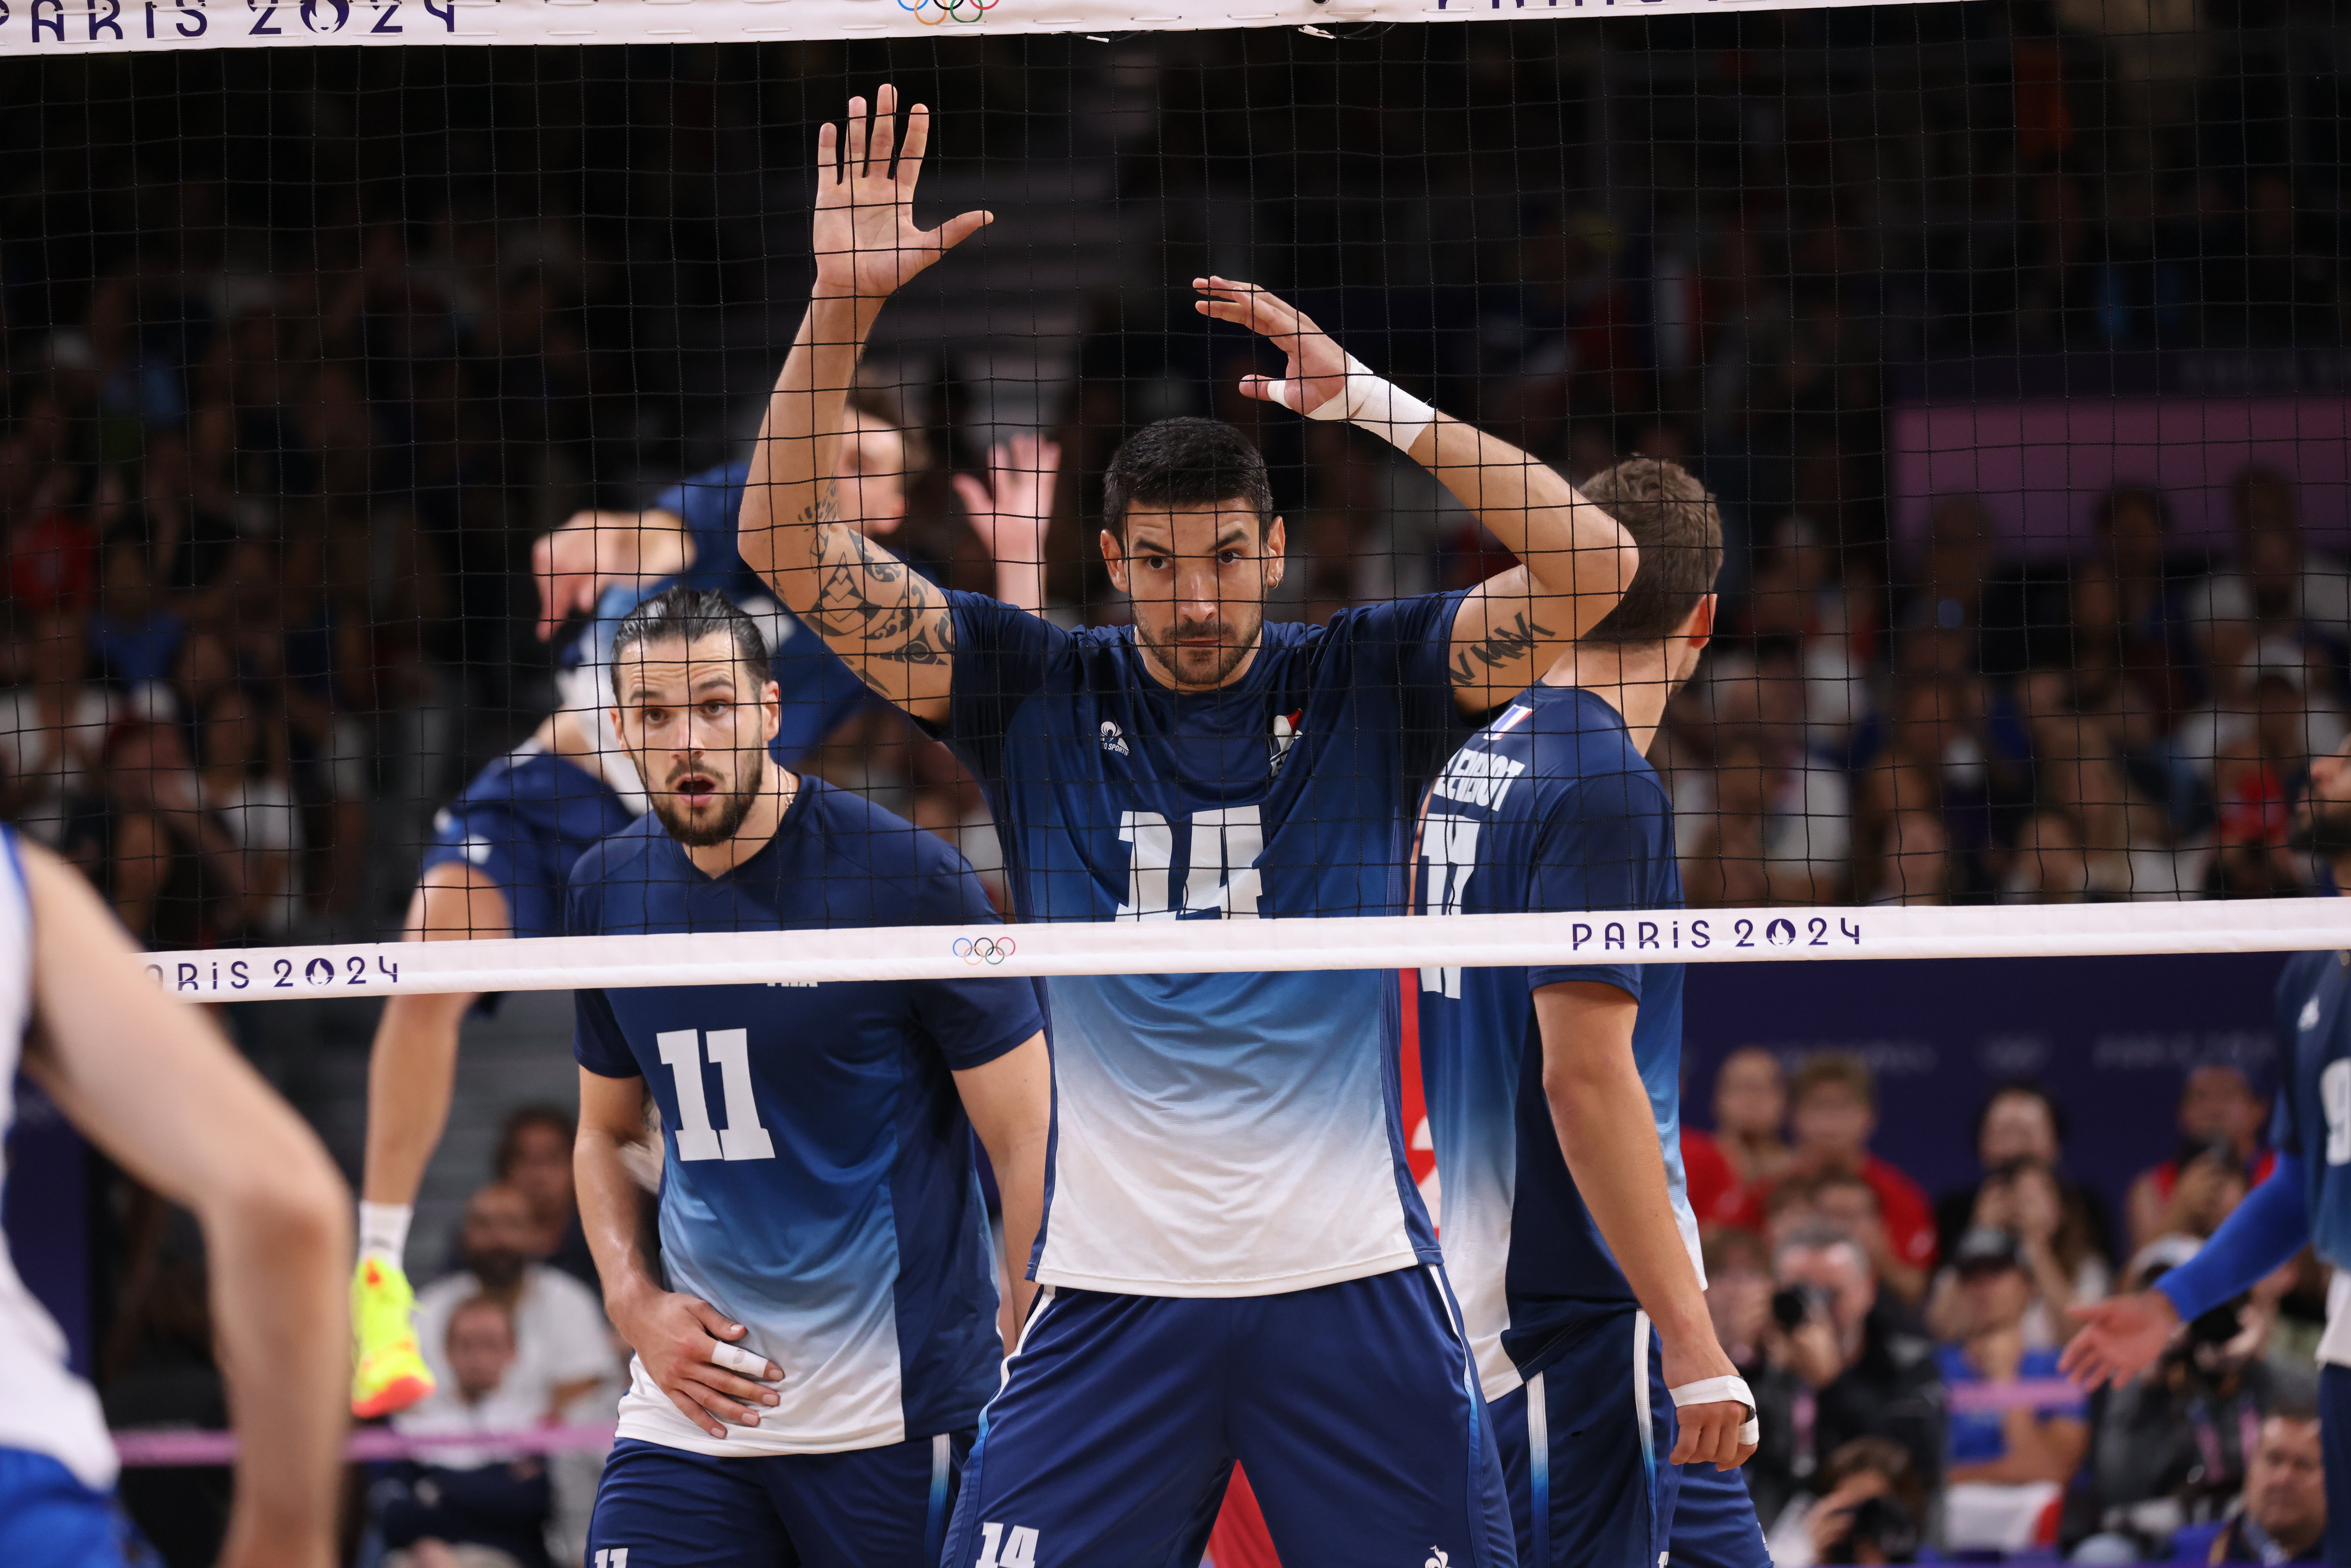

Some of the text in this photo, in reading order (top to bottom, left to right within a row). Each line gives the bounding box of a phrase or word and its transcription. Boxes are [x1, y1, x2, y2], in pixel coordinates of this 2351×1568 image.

[0, 0, 207, 43] ARiS
[1108, 743, 1129, 756] SPORTIF
[1115, 805, 1264, 922] 14
[1419, 812, 1481, 1000] 17
[1734, 917, 1860, 947] 2024
[274, 956, 397, 987] 2024
[656, 1028, 775, 1161] 11
[975, 1521, 1040, 1568] 14
